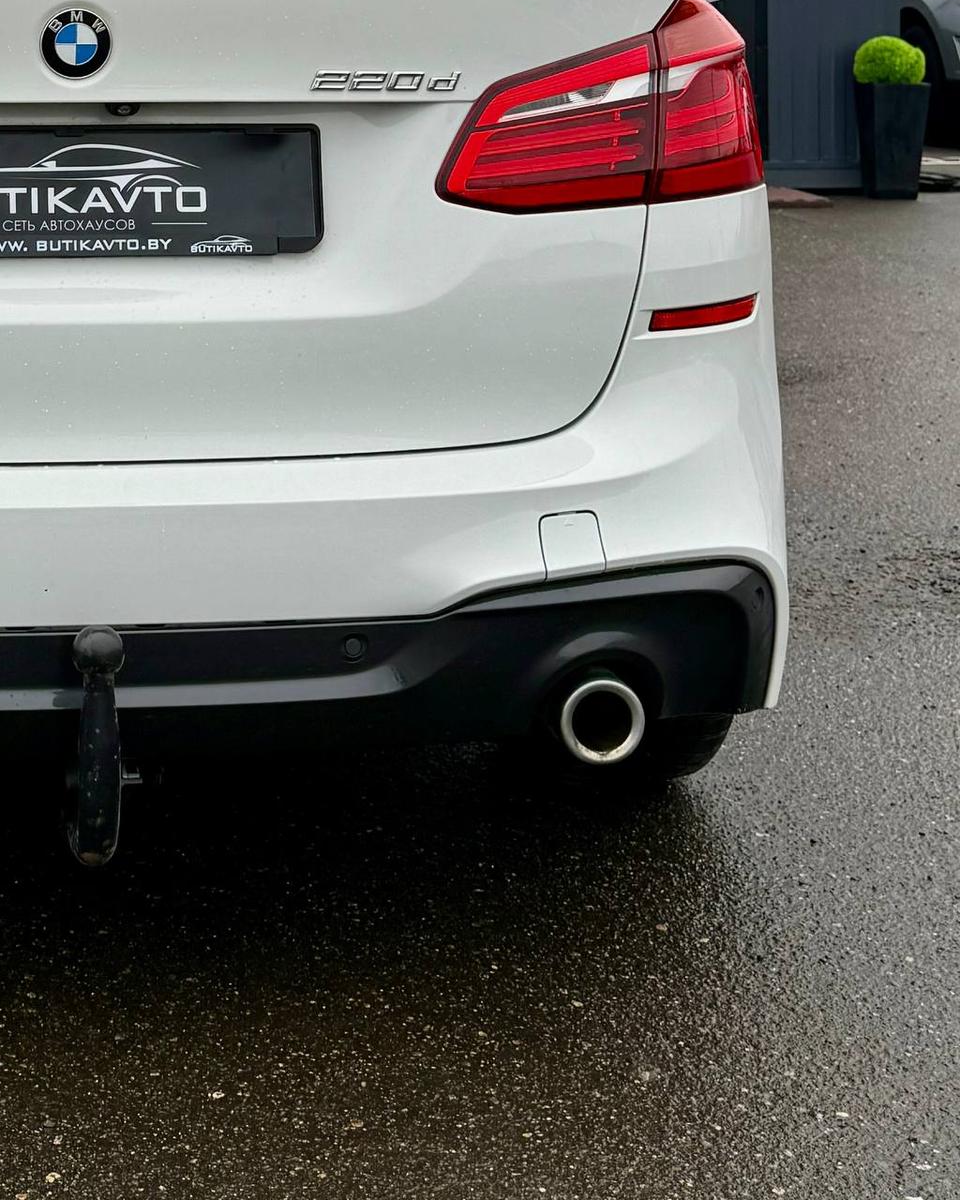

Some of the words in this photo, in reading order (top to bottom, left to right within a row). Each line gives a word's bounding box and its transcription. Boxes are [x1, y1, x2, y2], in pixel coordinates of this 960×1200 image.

[48, 10, 107, 33] BMW
[310, 69, 462, 92] 220d
[2, 219, 36, 232] СЕТЬ
[40, 218, 136, 231] АВТОХАУСОВ
[36, 238, 173, 252] BUTIKAVTO.BY
[190, 244, 253, 254] BUTIKAVTO
